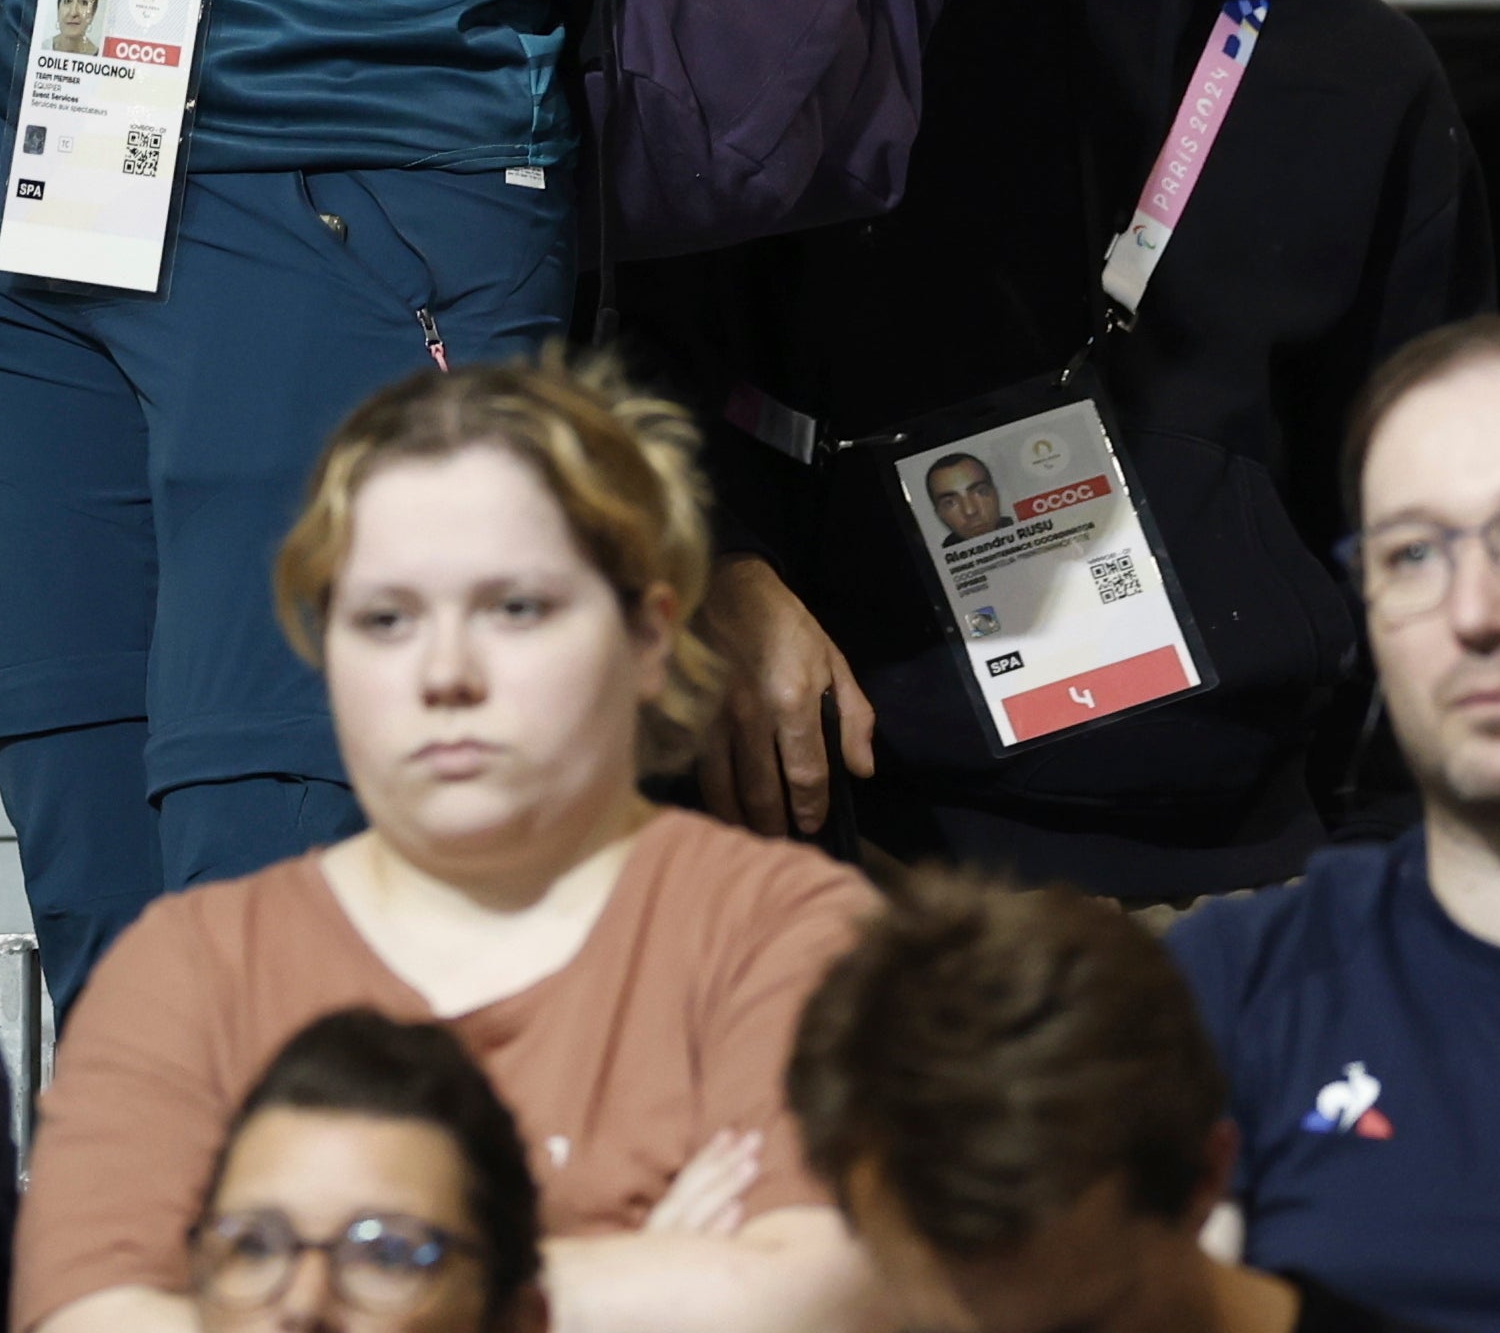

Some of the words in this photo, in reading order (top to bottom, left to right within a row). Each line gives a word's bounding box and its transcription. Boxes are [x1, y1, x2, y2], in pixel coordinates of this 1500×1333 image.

[116, 42, 166, 65] OCOG
[36, 72, 52, 82] TEAM
[54, 74, 80, 84] MEMBER
[38, 56, 69, 72] ODILE
[72, 59, 135, 80] TROUGNOU
[51, 92, 79, 103] Services
[19, 183, 42, 198] SPA
[1032, 484, 1094, 513] OCOG
[945, 534, 1015, 566] Alexandru
[1016, 519, 1054, 540] RUSU
[990, 655, 1021, 675] SPA
[1068, 686, 1096, 709] 4
